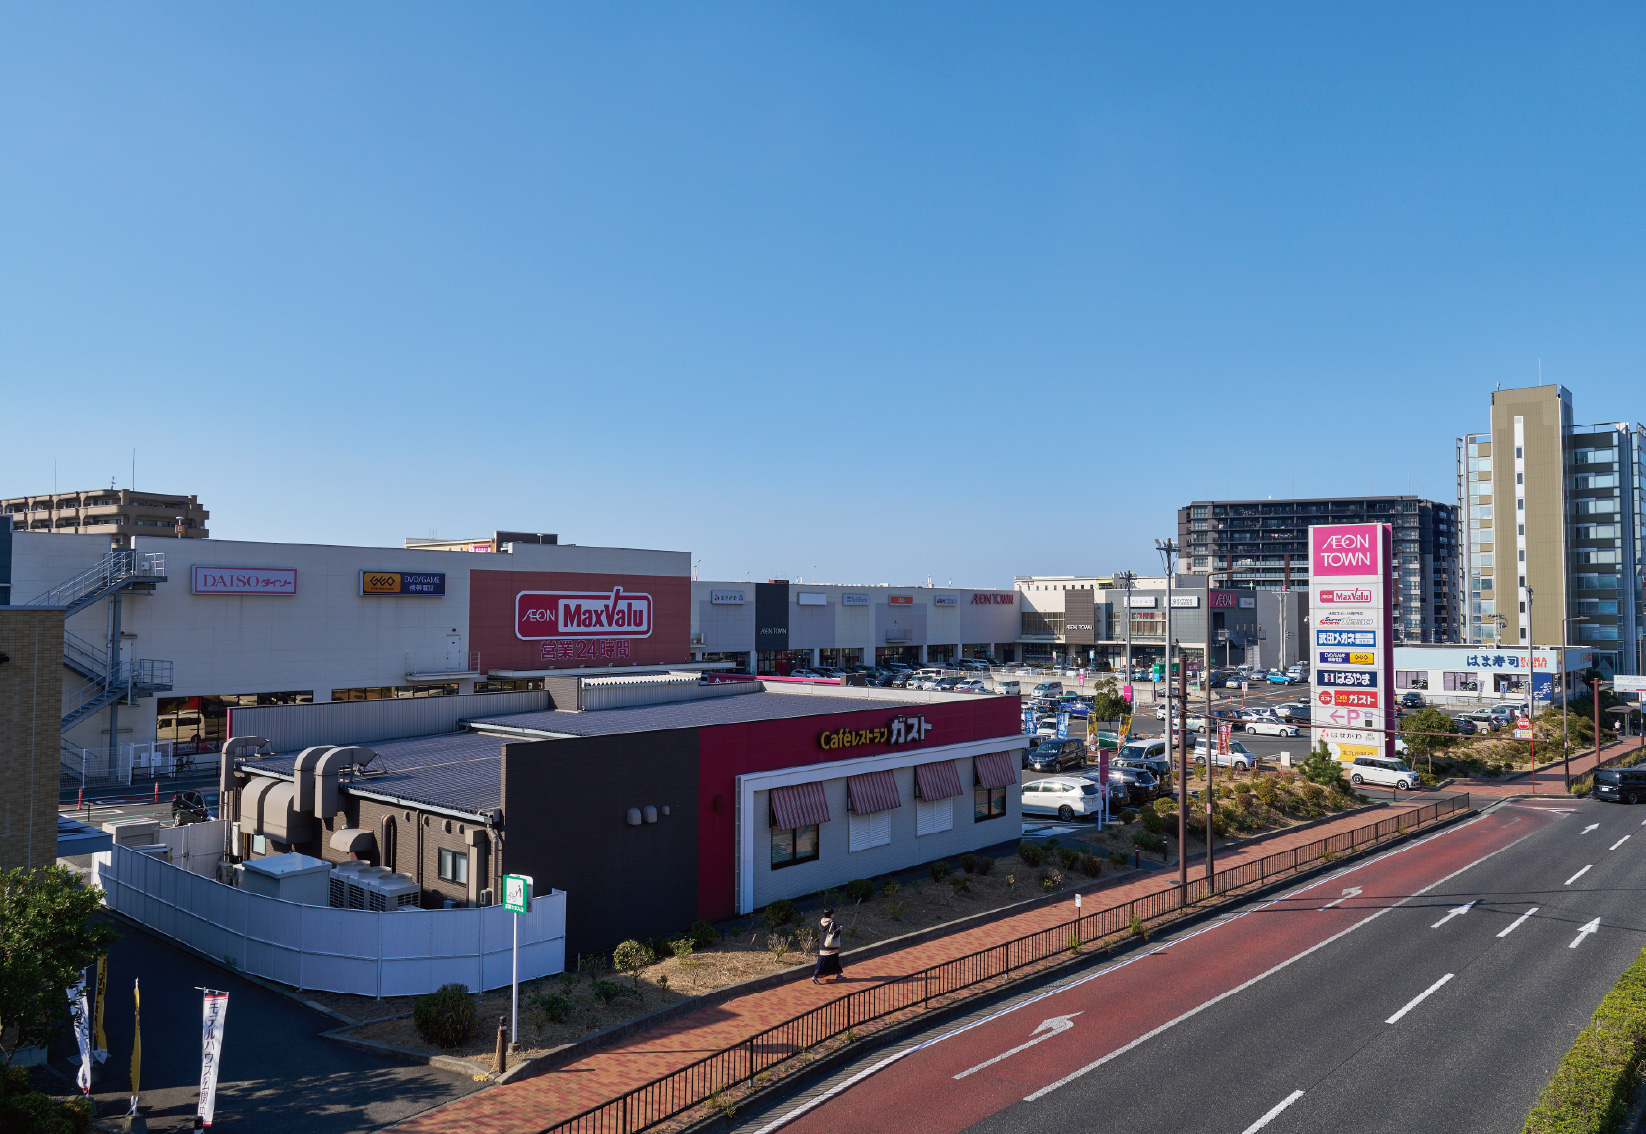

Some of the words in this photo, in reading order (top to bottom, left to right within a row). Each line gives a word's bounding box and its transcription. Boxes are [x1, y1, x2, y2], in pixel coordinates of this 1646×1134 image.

[1320, 552, 1371, 567] TOWN
[203, 574, 259, 588] DAISO
[261, 578, 292, 588] ダイソー
[992, 593, 1014, 605] TOWN
[1335, 587, 1369, 601] MaxValu
[563, 588, 644, 628] MaxValu
[1318, 632, 1355, 645] 武田メガネ
[540, 639, 631, 660] 営業24時間
[1466, 654, 1520, 668] はま寿司
[1335, 672, 1370, 685] はるやま
[1348, 694, 1376, 705] ガスト
[891, 716, 933, 745] ガスト
